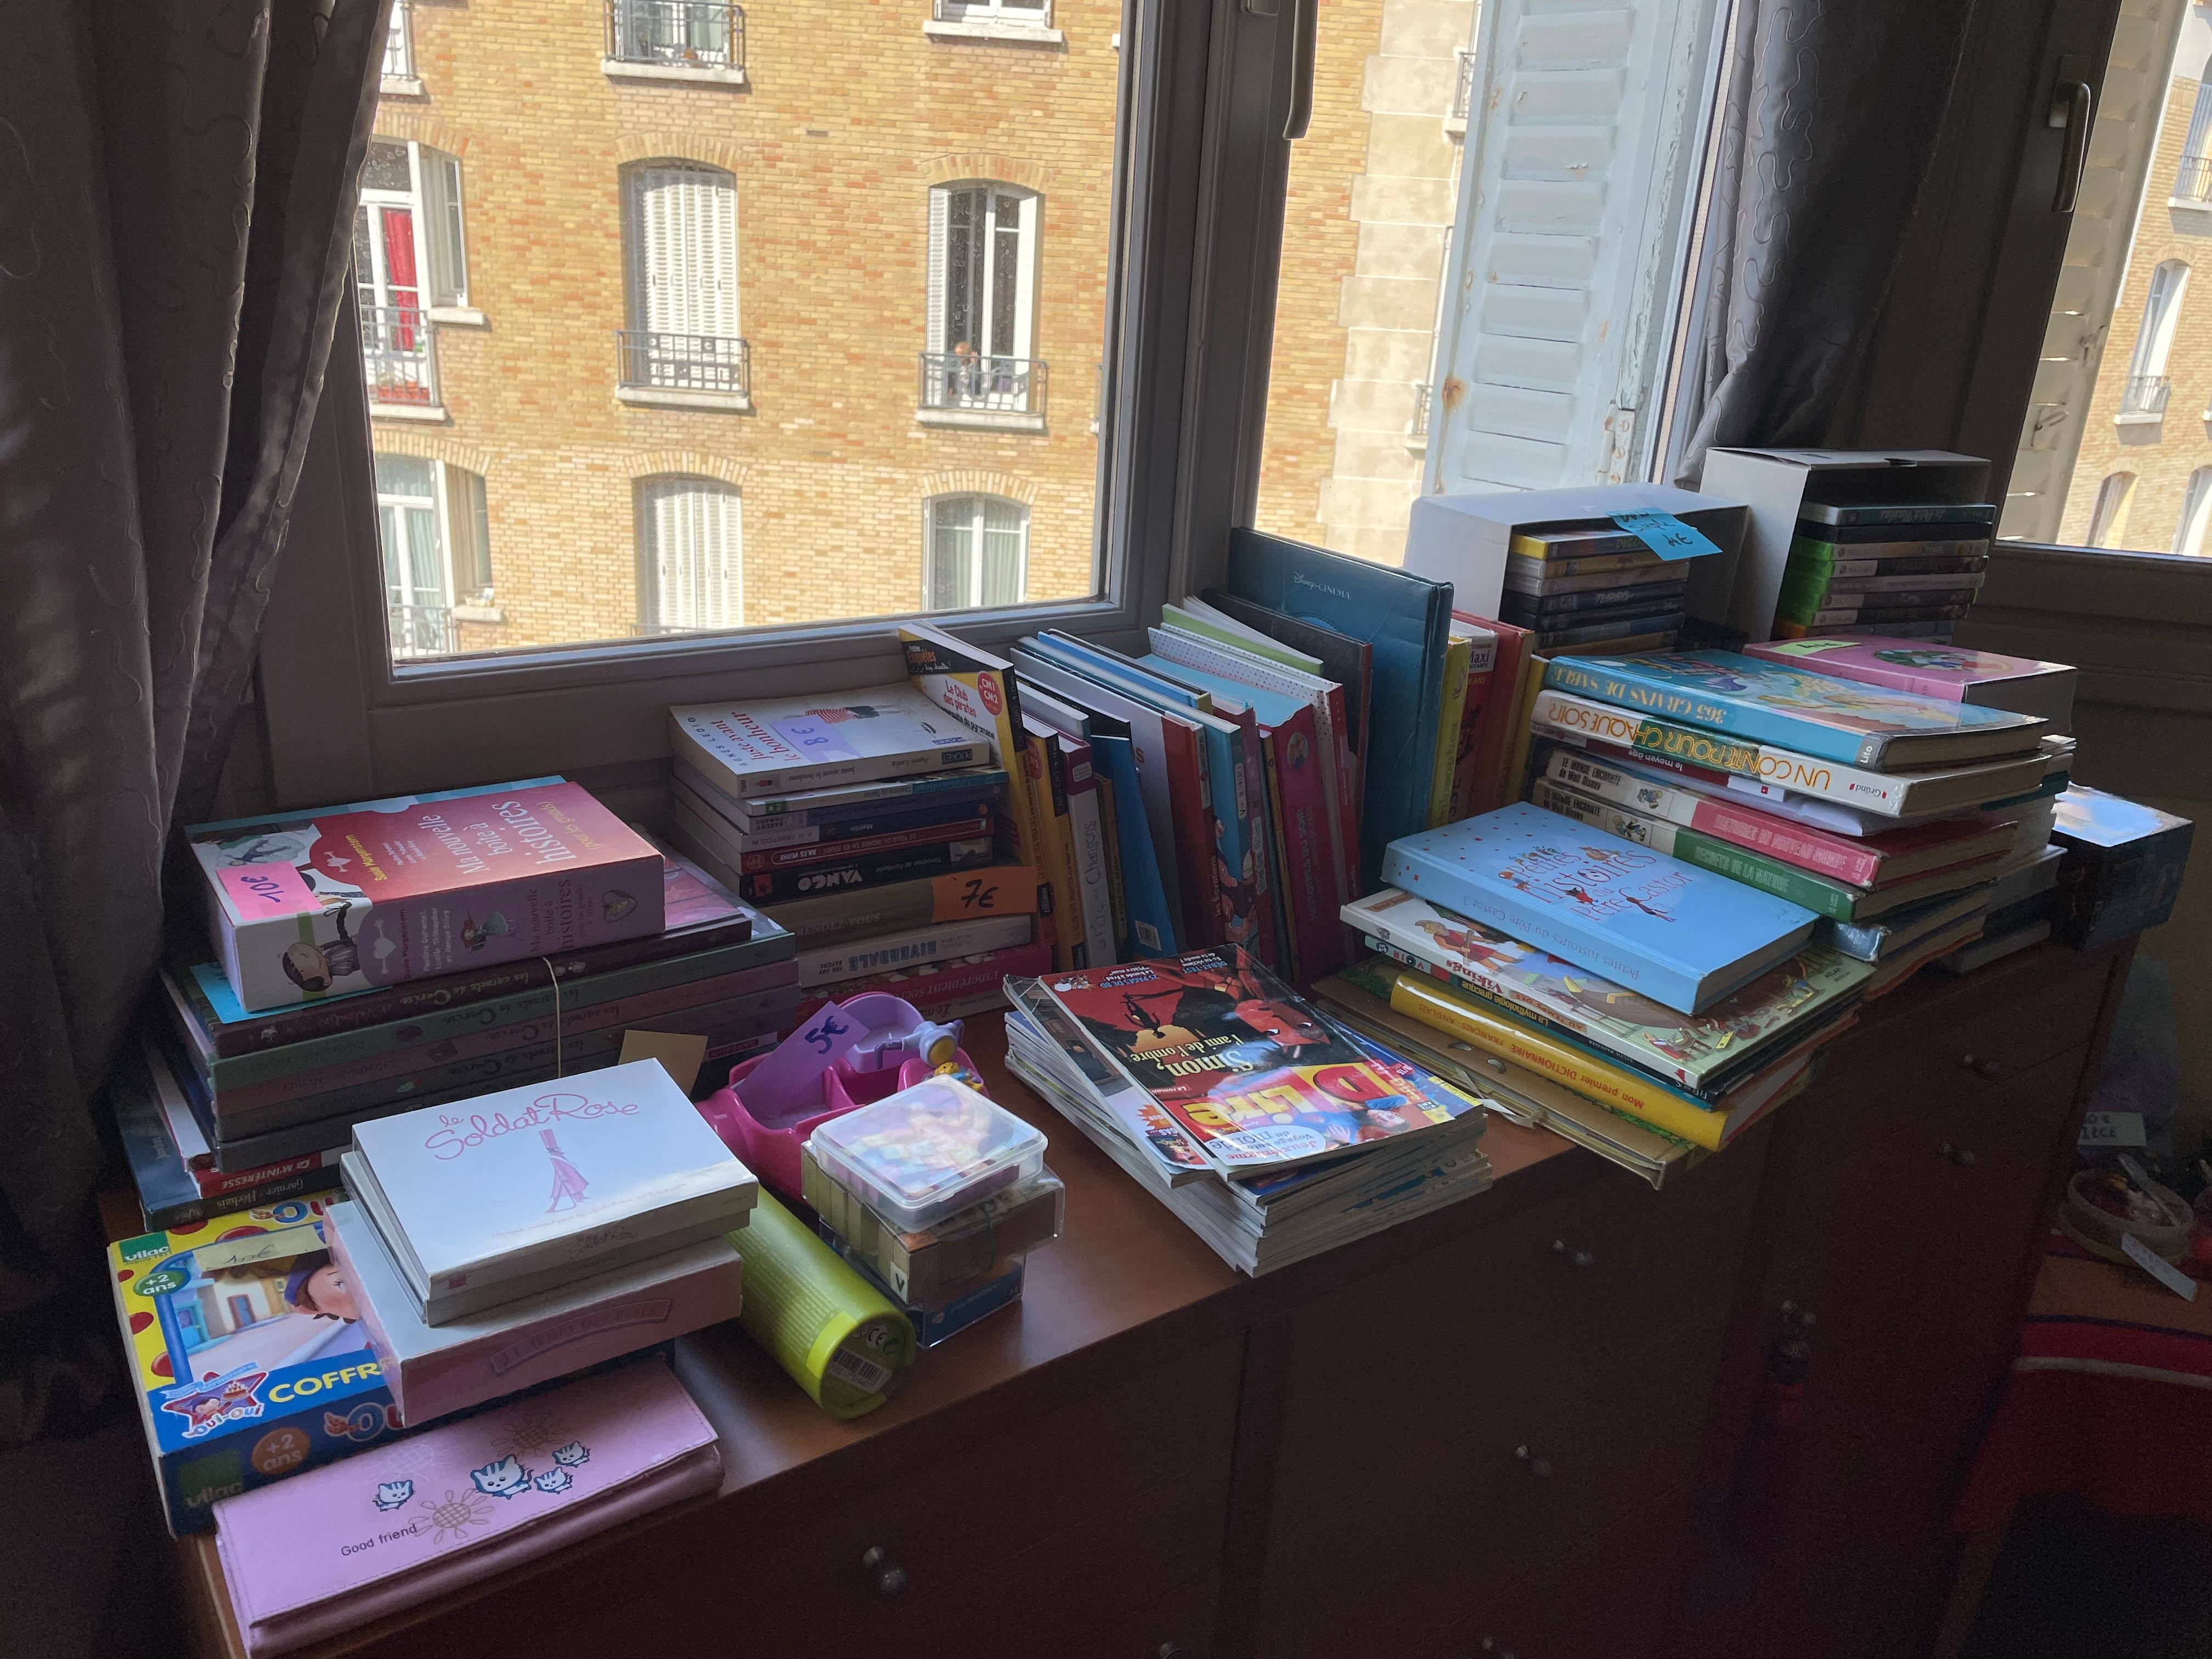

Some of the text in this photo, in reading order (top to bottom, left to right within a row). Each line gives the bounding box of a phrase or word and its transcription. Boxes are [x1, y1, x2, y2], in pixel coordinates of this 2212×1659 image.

[945, 680, 968, 701] Le Club
[981, 678, 995, 691] CM1
[1553, 667, 1727, 724] 365 GRAINS DE SABLE
[943, 693, 977, 718] des pirates
[983, 691, 998, 704] CM2
[1548, 701, 1590, 728] SOIR
[688, 717, 716, 742] LEDIG
[710, 720, 774, 760] Juste avant
[731, 712, 789, 754] bonheur
[970, 720, 995, 740] pyromane
[1590, 711, 1663, 747] CHAQUE
[942, 749, 972, 764] POCKET
[1628, 748, 1683, 771] le moyen âge
[1663, 733, 1723, 764] POUR
[1860, 745, 1873, 764] Lito
[822, 769, 839, 777] avant
[841, 766, 855, 775] Juste
[892, 757, 928, 769] Agnès Ledig
[1562, 757, 1622, 786] LE MONDE ENCHANTÉ
[1726, 748, 1792, 780] CONTE
[788, 772, 814, 783] bonheur
[1559, 768, 1602, 792] de Walt Disney
[1795, 765, 1830, 791] UN
[1854, 782, 1882, 798] Gründ
[1544, 788, 1552, 800] LE
[1572, 798, 1602, 817] ENCHANTÉ
[492, 800, 578, 865] histoires
[850, 822, 873, 832] Merlin
[1294, 806, 1307, 837] SOIR
[417, 814, 490, 876] Ma nouvelle
[476, 832, 515, 856] boîte
[1299, 839, 1310, 856] DU
[1713, 814, 1757, 842] HISTOIRES
[1758, 828, 1771, 844] DU
[1772, 833, 1812, 859] NOUVEAU
[1812, 845, 1848, 870] MONDE
[346, 834, 387, 882] Susie Morgenstern
[780, 851, 798, 861] VERNE
[1506, 850, 1581, 878] Petites
[797, 867, 871, 891] VANGO
[1694, 846, 1791, 893] SECRETS DE LA NATURE
[961, 879, 995, 909] 7€
[1571, 871, 1694, 921] Père Castor
[1591, 885, 1615, 897] du
[527, 887, 541, 951] Ma nouvelle
[555, 879, 574, 951] histoires
[1463, 895, 1640, 980] Petites histoires du Père Castor 3
[820, 960, 842, 969] BEFORE
[849, 940, 936, 971] RIVERDALE
[1182, 960, 1204, 968] victime
[1182, 960, 1228, 974] DÉBAT-TEST
[1126, 975, 1148, 984] PAGES
[1446, 959, 1504, 994] Vikings
[397, 972, 529, 1012] les carnets de Cerise
[1461, 980, 1549, 1028] La mythologie grecque
[1515, 993, 1584, 1031] AU TEMPS DES
[804, 1014, 849, 1054] 5€
[1186, 1032, 1246, 1055] l'ami de
[1155, 1049, 1254, 1082] Simon,
[1418, 1003, 1644, 1109] Mon premier DICTIONNAIRE FRANÇAIS ANGLAIS
[424, 1093, 640, 1160] Soldat Rose
[439, 1114, 464, 1127] le
[1274, 1134, 1314, 1145] Voyage
[221, 1163, 294, 1189] M'INTÉRESSE
[266, 1178, 303, 1197] Garnier
[124, 1246, 170, 1262] vilac
[143, 1282, 177, 1295] ans
[145, 1274, 170, 1286] +2
[267, 1434, 295, 1453] +2
[263, 1449, 303, 1471] ans
[185, 1482, 243, 1508] vilac
[341, 1523, 417, 1556] Good friend
